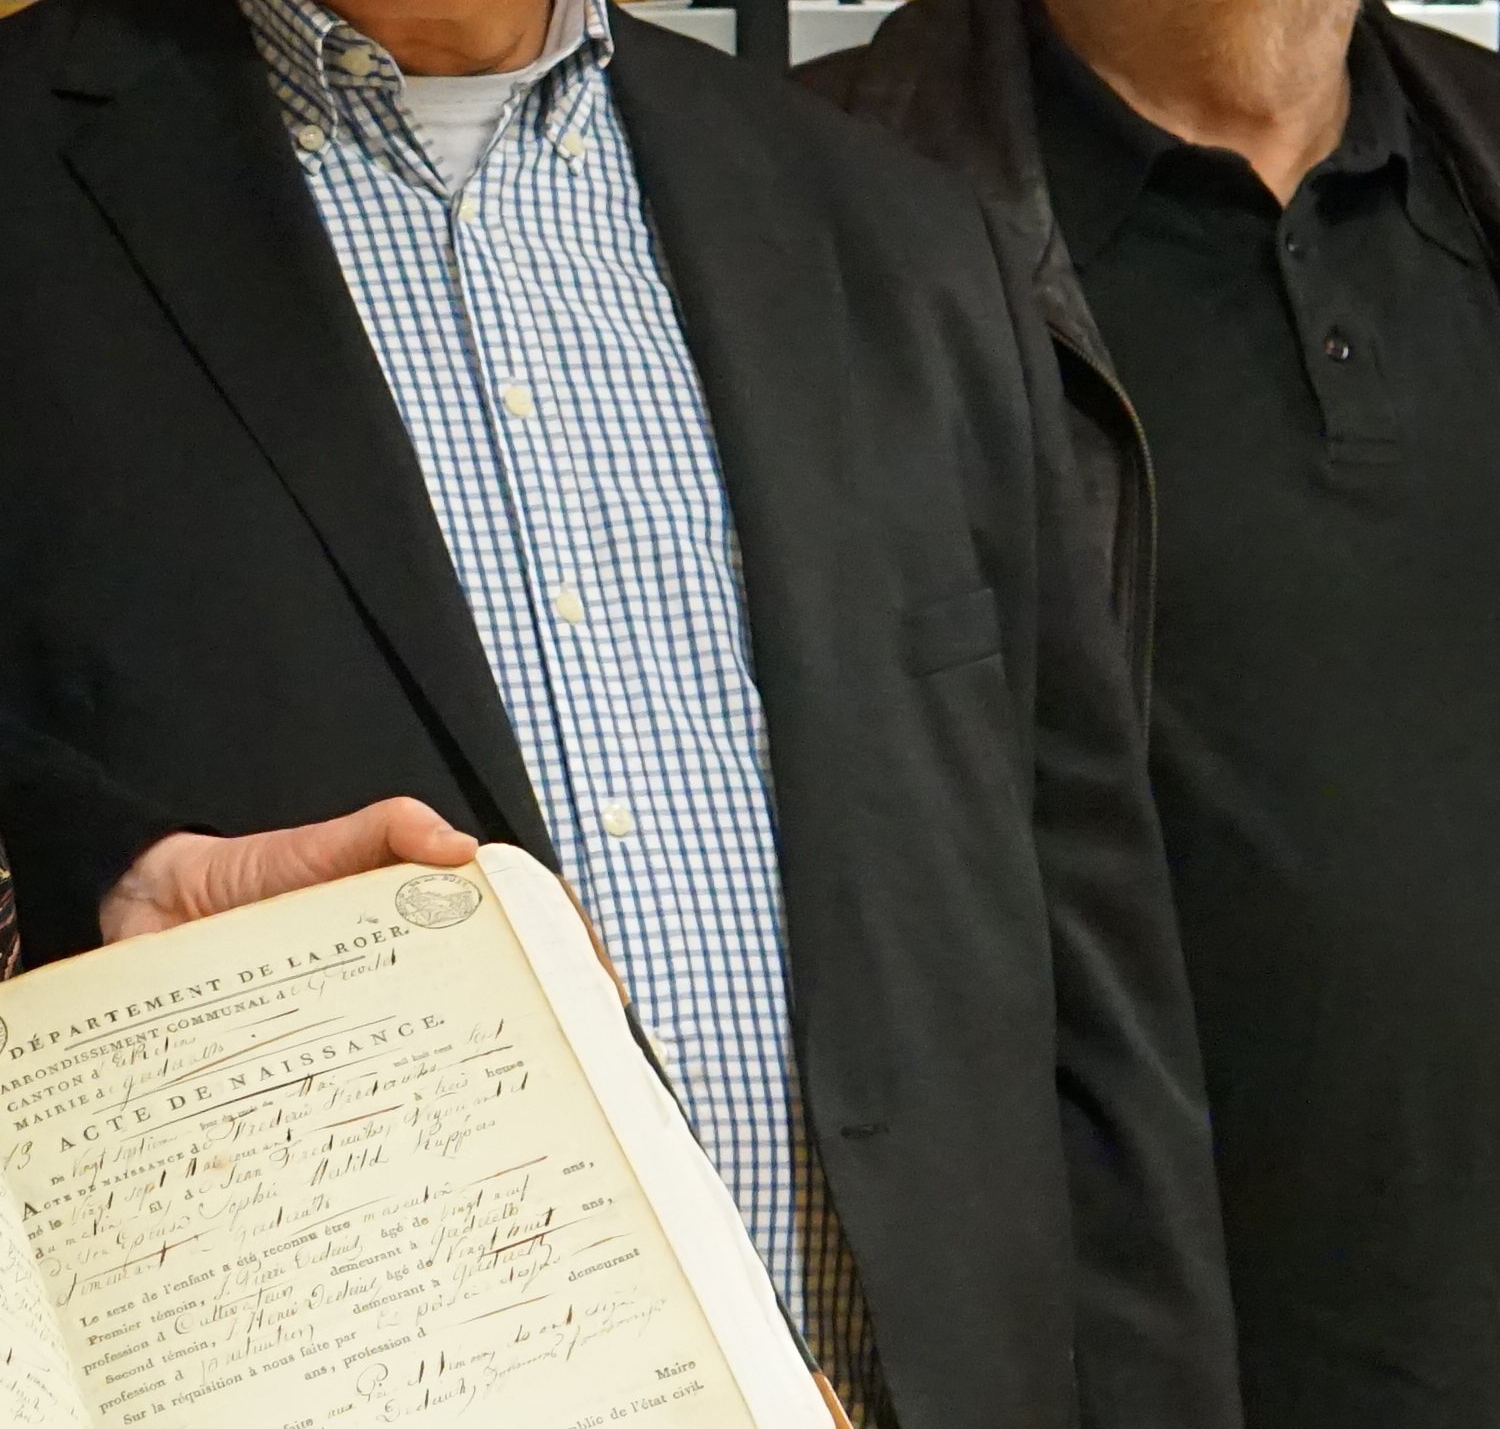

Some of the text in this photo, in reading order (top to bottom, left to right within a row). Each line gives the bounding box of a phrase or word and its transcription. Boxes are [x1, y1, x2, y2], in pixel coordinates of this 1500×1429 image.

[0, 1029, 161, 1096] ARRONDISSEMENT
[166, 993, 272, 1035] COMMUNAL
[8, 925, 411, 1061] DÉPARTEMENT DE LA ROER.
[6, 1069, 85, 1114] CANTON
[13, 1093, 93, 1132] MAIRIE
[58, 1013, 447, 1152] ACTE DE NAISSANCE.
[21, 1190, 73, 1222] ACTE
[103, 1152, 185, 1186] NAISSANCE
[26, 1229, 44, 1241] né
[49, 1219, 64, 1230] le
[79, 1315, 100, 1329] Le
[105, 1301, 136, 1319] sexe
[141, 1293, 159, 1307] de
[163, 1269, 216, 1296] l'enfant
[222, 1263, 231, 1274] a
[236, 1253, 256, 1268] été
[262, 1232, 318, 1259] reconnu
[324, 1220, 352, 1238] être
[87, 1321, 142, 1347] Premier
[150, 1299, 206, 1324] témoin,
[380, 1220, 408, 1240] âgé
[412, 1216, 431, 1230] de
[562, 1159, 595, 1176] ans,
[105, 1359, 155, 1385] Second
[161, 1339, 217, 1364] témoin,
[385, 1262, 413, 1283] âgé
[581, 1196, 614, 1213] ans,
[81, 1337, 151, 1377] profession
[329, 1243, 411, 1278] demeurant
[409, 1239, 419, 1251] à
[98, 1379, 174, 1414] profession
[352, 1281, 432, 1316] demeurant
[431, 1278, 441, 1288] à
[122, 1410, 147, 1426] Sur
[151, 1403, 166, 1415] la
[171, 1371, 244, 1407] réquisition
[249, 1366, 259, 1378] à
[262, 1353, 296, 1372] nous
[300, 1339, 331, 1359] faite
[333, 1330, 358, 1349] par
[567, 1248, 642, 1283] demeurant
[303, 1328, 428, 1382] ans, profession d
[610, 1408, 628, 1420] de
[630, 1399, 667, 1413] l'état
[655, 1360, 696, 1381] Maire
